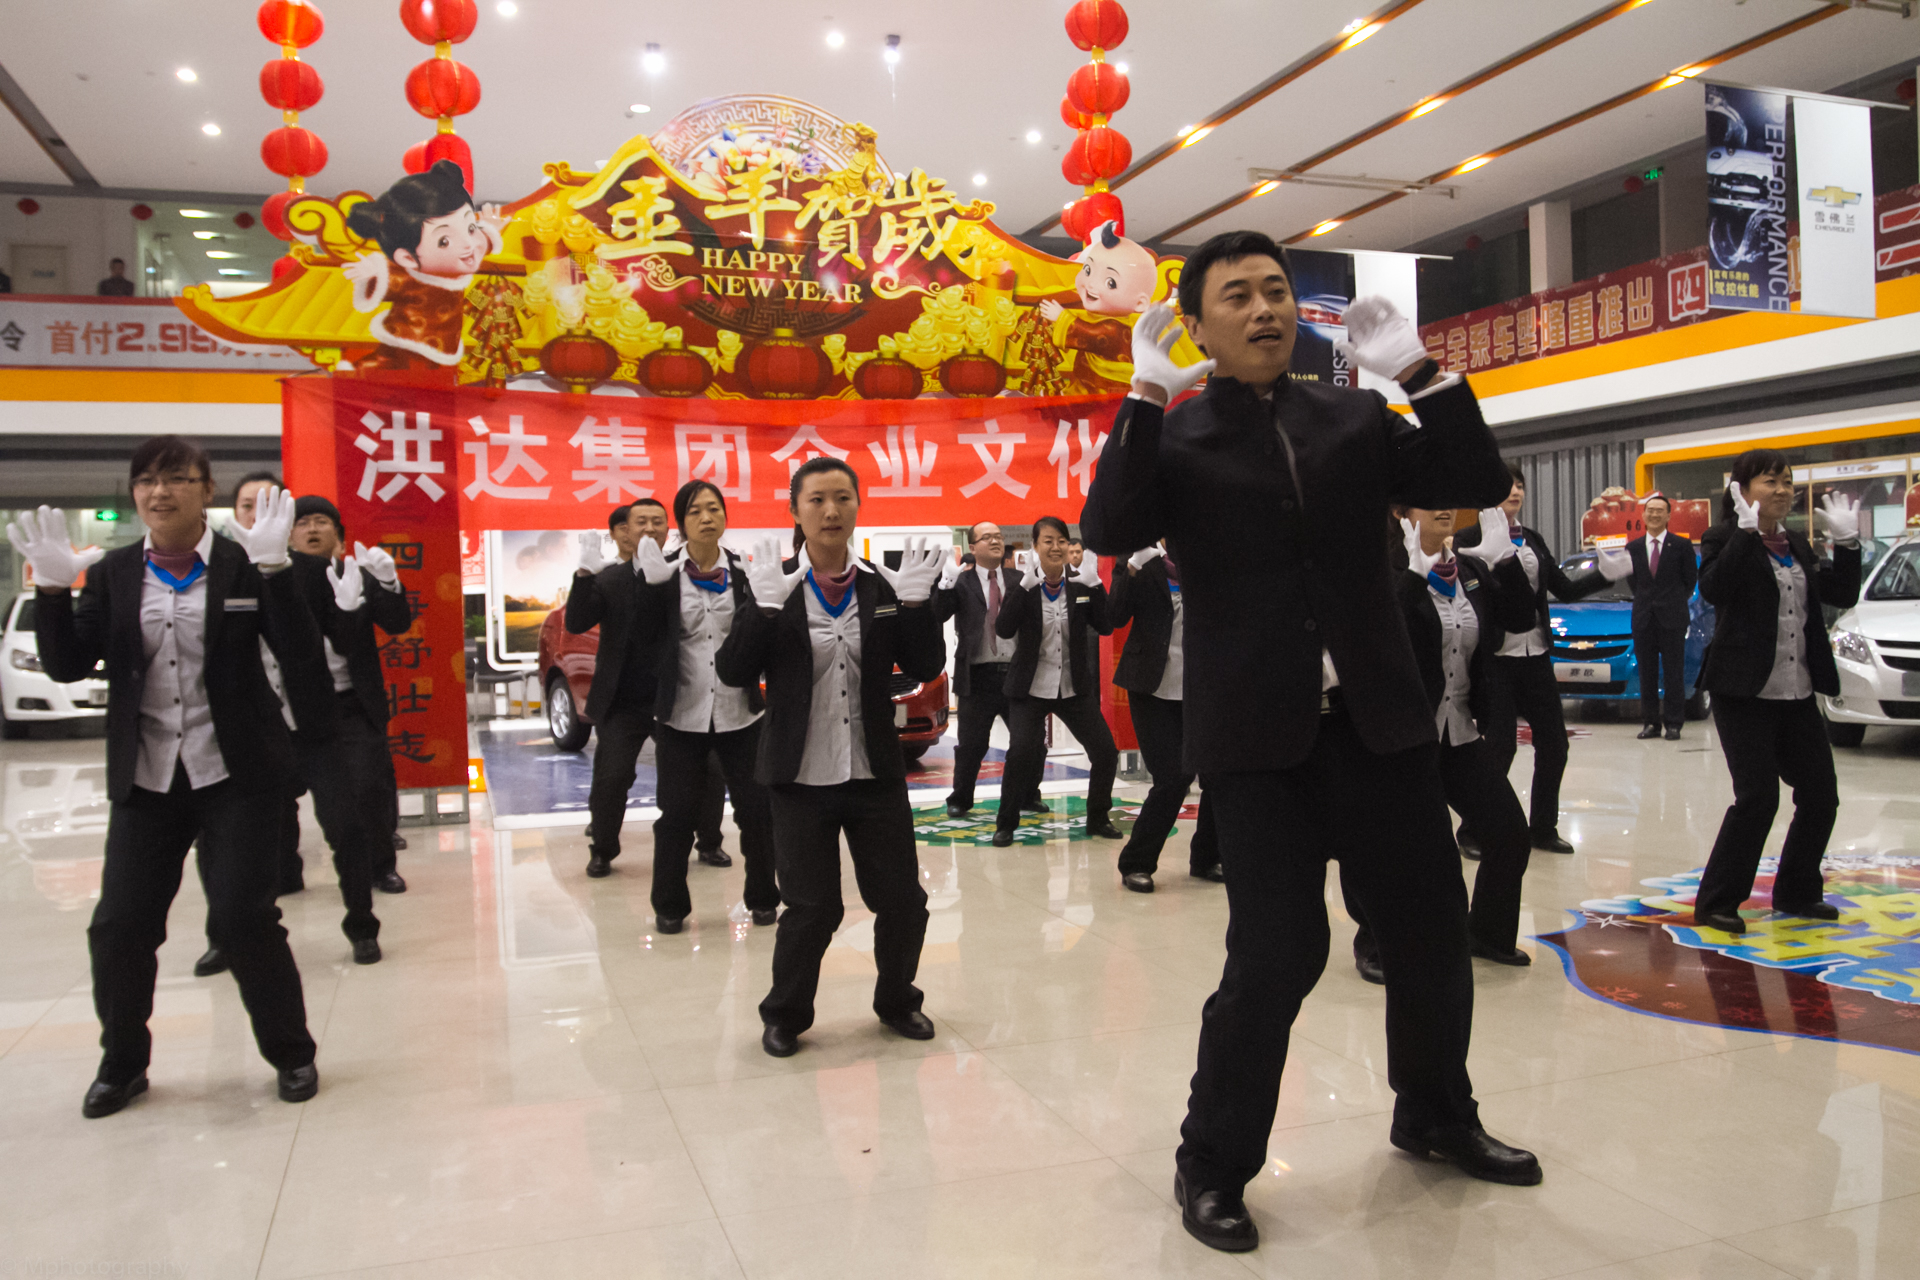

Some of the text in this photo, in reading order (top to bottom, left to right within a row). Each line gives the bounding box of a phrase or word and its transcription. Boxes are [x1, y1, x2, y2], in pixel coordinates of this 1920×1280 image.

[1814, 224, 1855, 233] CHEVROLET
[701, 247, 805, 274] HAPPY
[701, 274, 863, 304] NEW YEAR
[353, 410, 1109, 504] 洪达集团企业文化
